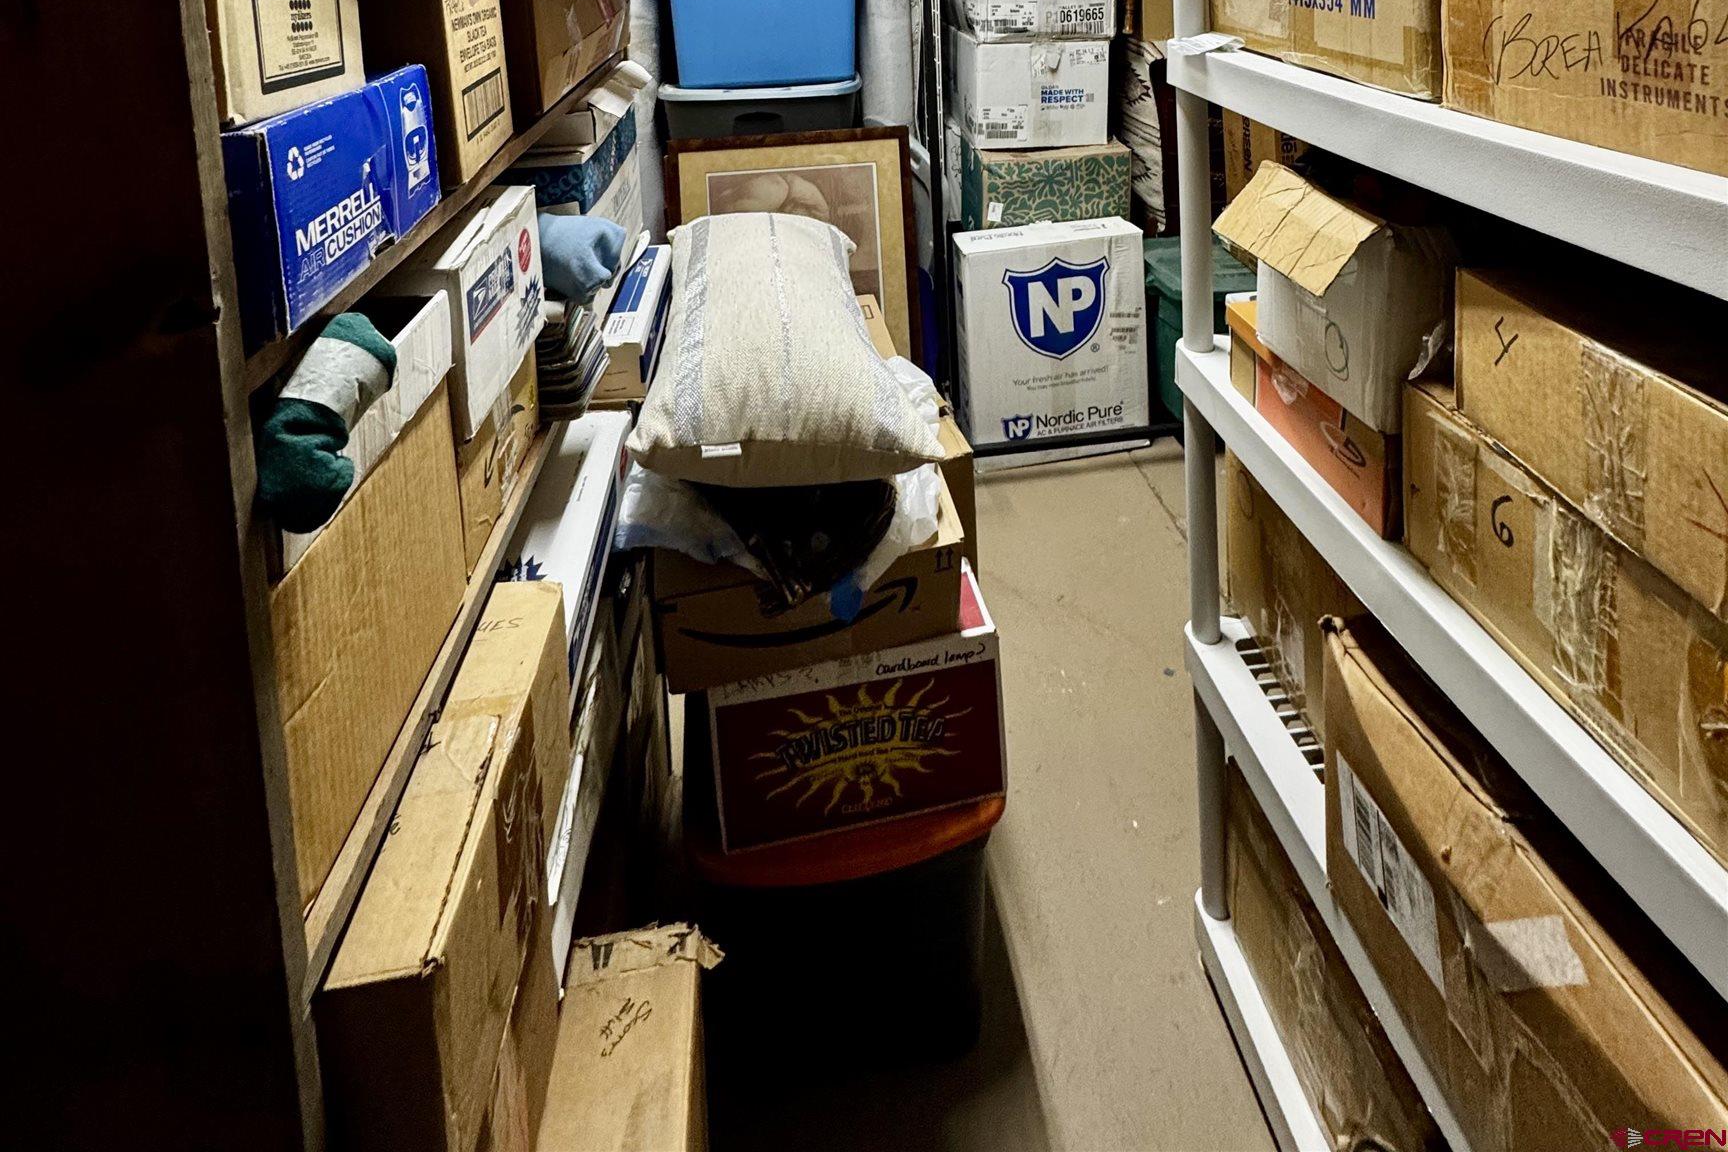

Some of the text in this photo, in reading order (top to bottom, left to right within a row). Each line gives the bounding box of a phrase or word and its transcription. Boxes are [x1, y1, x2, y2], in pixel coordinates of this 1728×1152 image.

[1620, 54, 1710, 85] DELICATE
[1041, 95, 1084, 103] RESPECT
[295, 182, 381, 256] MERRELL
[300, 202, 382, 281] AIR CUSHION
[1027, 276, 1096, 338] NP
[1008, 404, 1123, 438] NP Nordic Pure
[1098, 417, 1124, 426] FILTERS
[1491, 495, 1514, 548] 6
[777, 715, 897, 769] TWISTED
[900, 713, 945, 742] TEA
